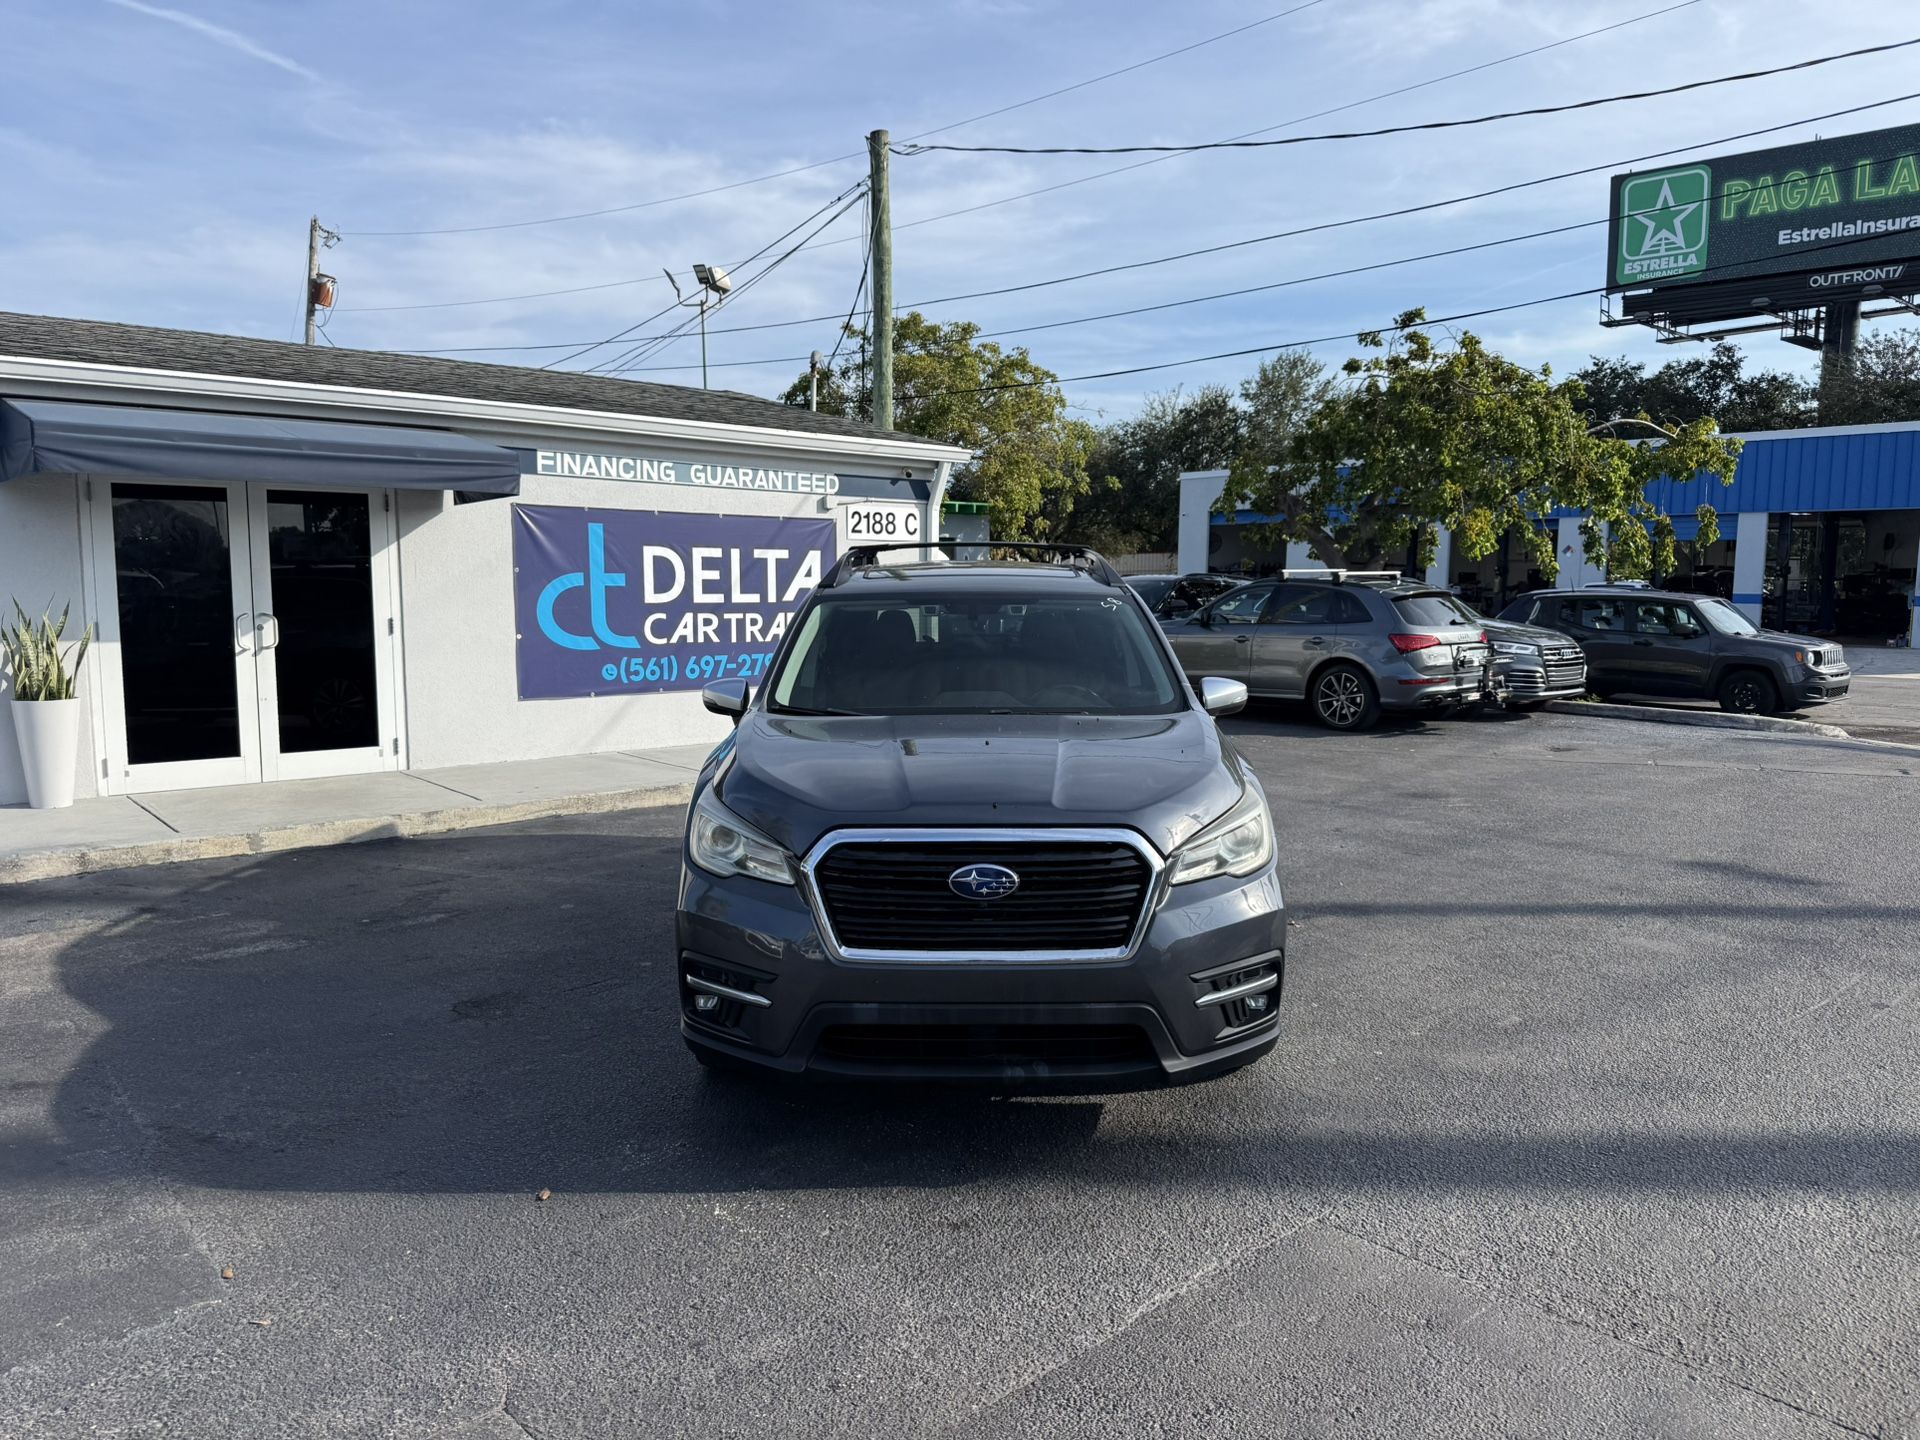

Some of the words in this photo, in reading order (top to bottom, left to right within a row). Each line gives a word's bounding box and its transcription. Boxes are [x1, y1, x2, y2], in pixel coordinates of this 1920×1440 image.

[1722, 166, 1839, 219] PAGA
[1855, 154, 1920, 200] LA
[1623, 253, 1698, 275] ESTRELLA
[1636, 267, 1684, 280] INSURANCE
[536, 451, 675, 483] FINANCING
[690, 464, 840, 495] GUARANTEED
[851, 510, 896, 535] 2188
[905, 512, 918, 535] C
[643, 545, 822, 604] DELTA
[643, 612, 720, 645] CAR
[723, 612, 796, 643] TRA
[619, 655, 678, 684] (561)
